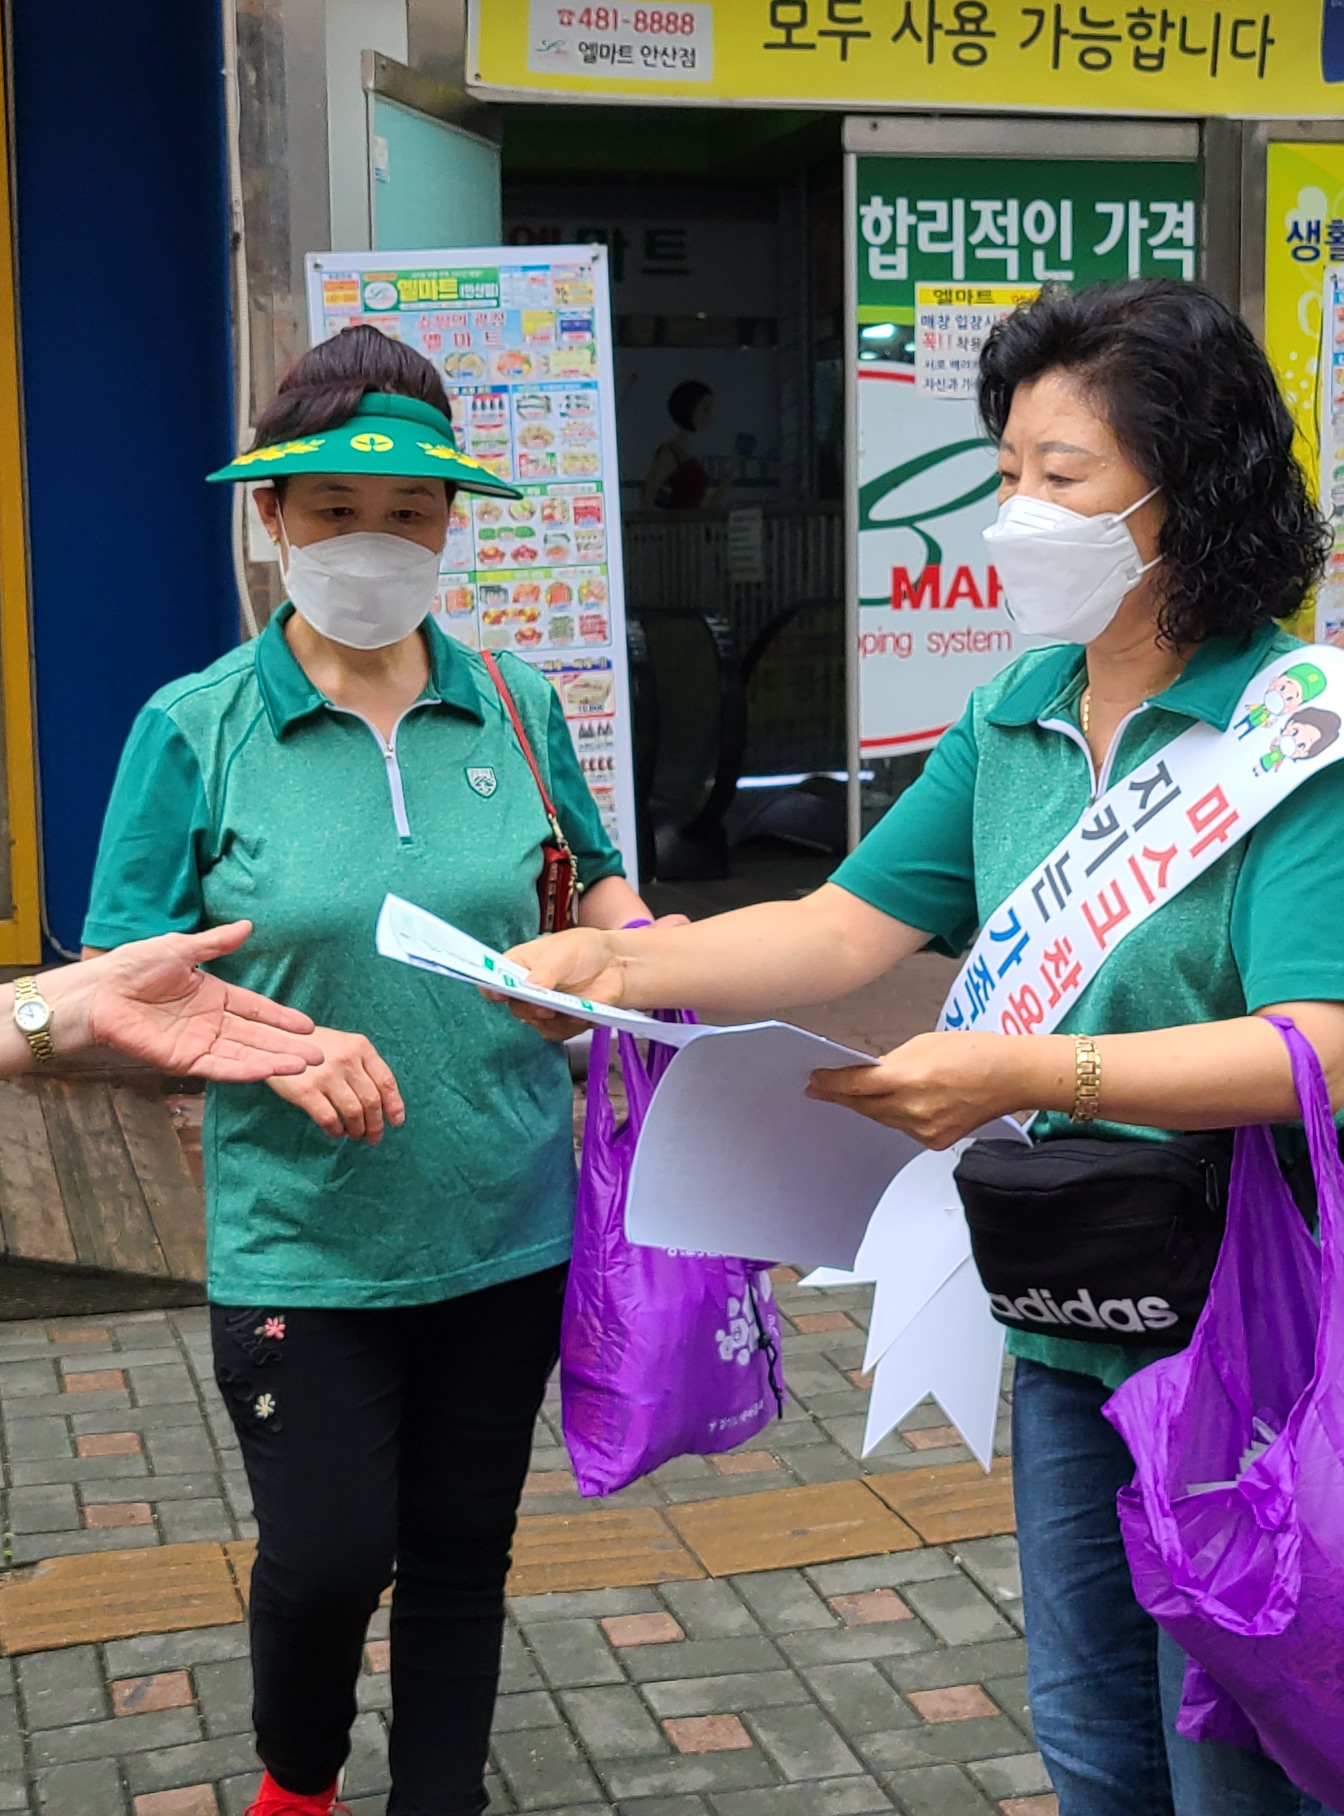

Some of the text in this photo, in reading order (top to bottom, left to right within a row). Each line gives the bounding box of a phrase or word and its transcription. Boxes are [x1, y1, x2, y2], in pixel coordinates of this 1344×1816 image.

[578, 6, 696, 36] 481-8888
[763, 0, 1276, 79] 모두 사용 가능합니다
[578, 41, 696, 69] 엘마트 안산점
[859, 195, 1195, 282] 합리적인 가격
[933, 288, 996, 306] 엘마트
[927, 624, 1012, 659] system
[1030, 760, 1182, 923] 지키는
[1080, 783, 1240, 951] 마스크
[990, 1287, 1179, 1333] adidas
